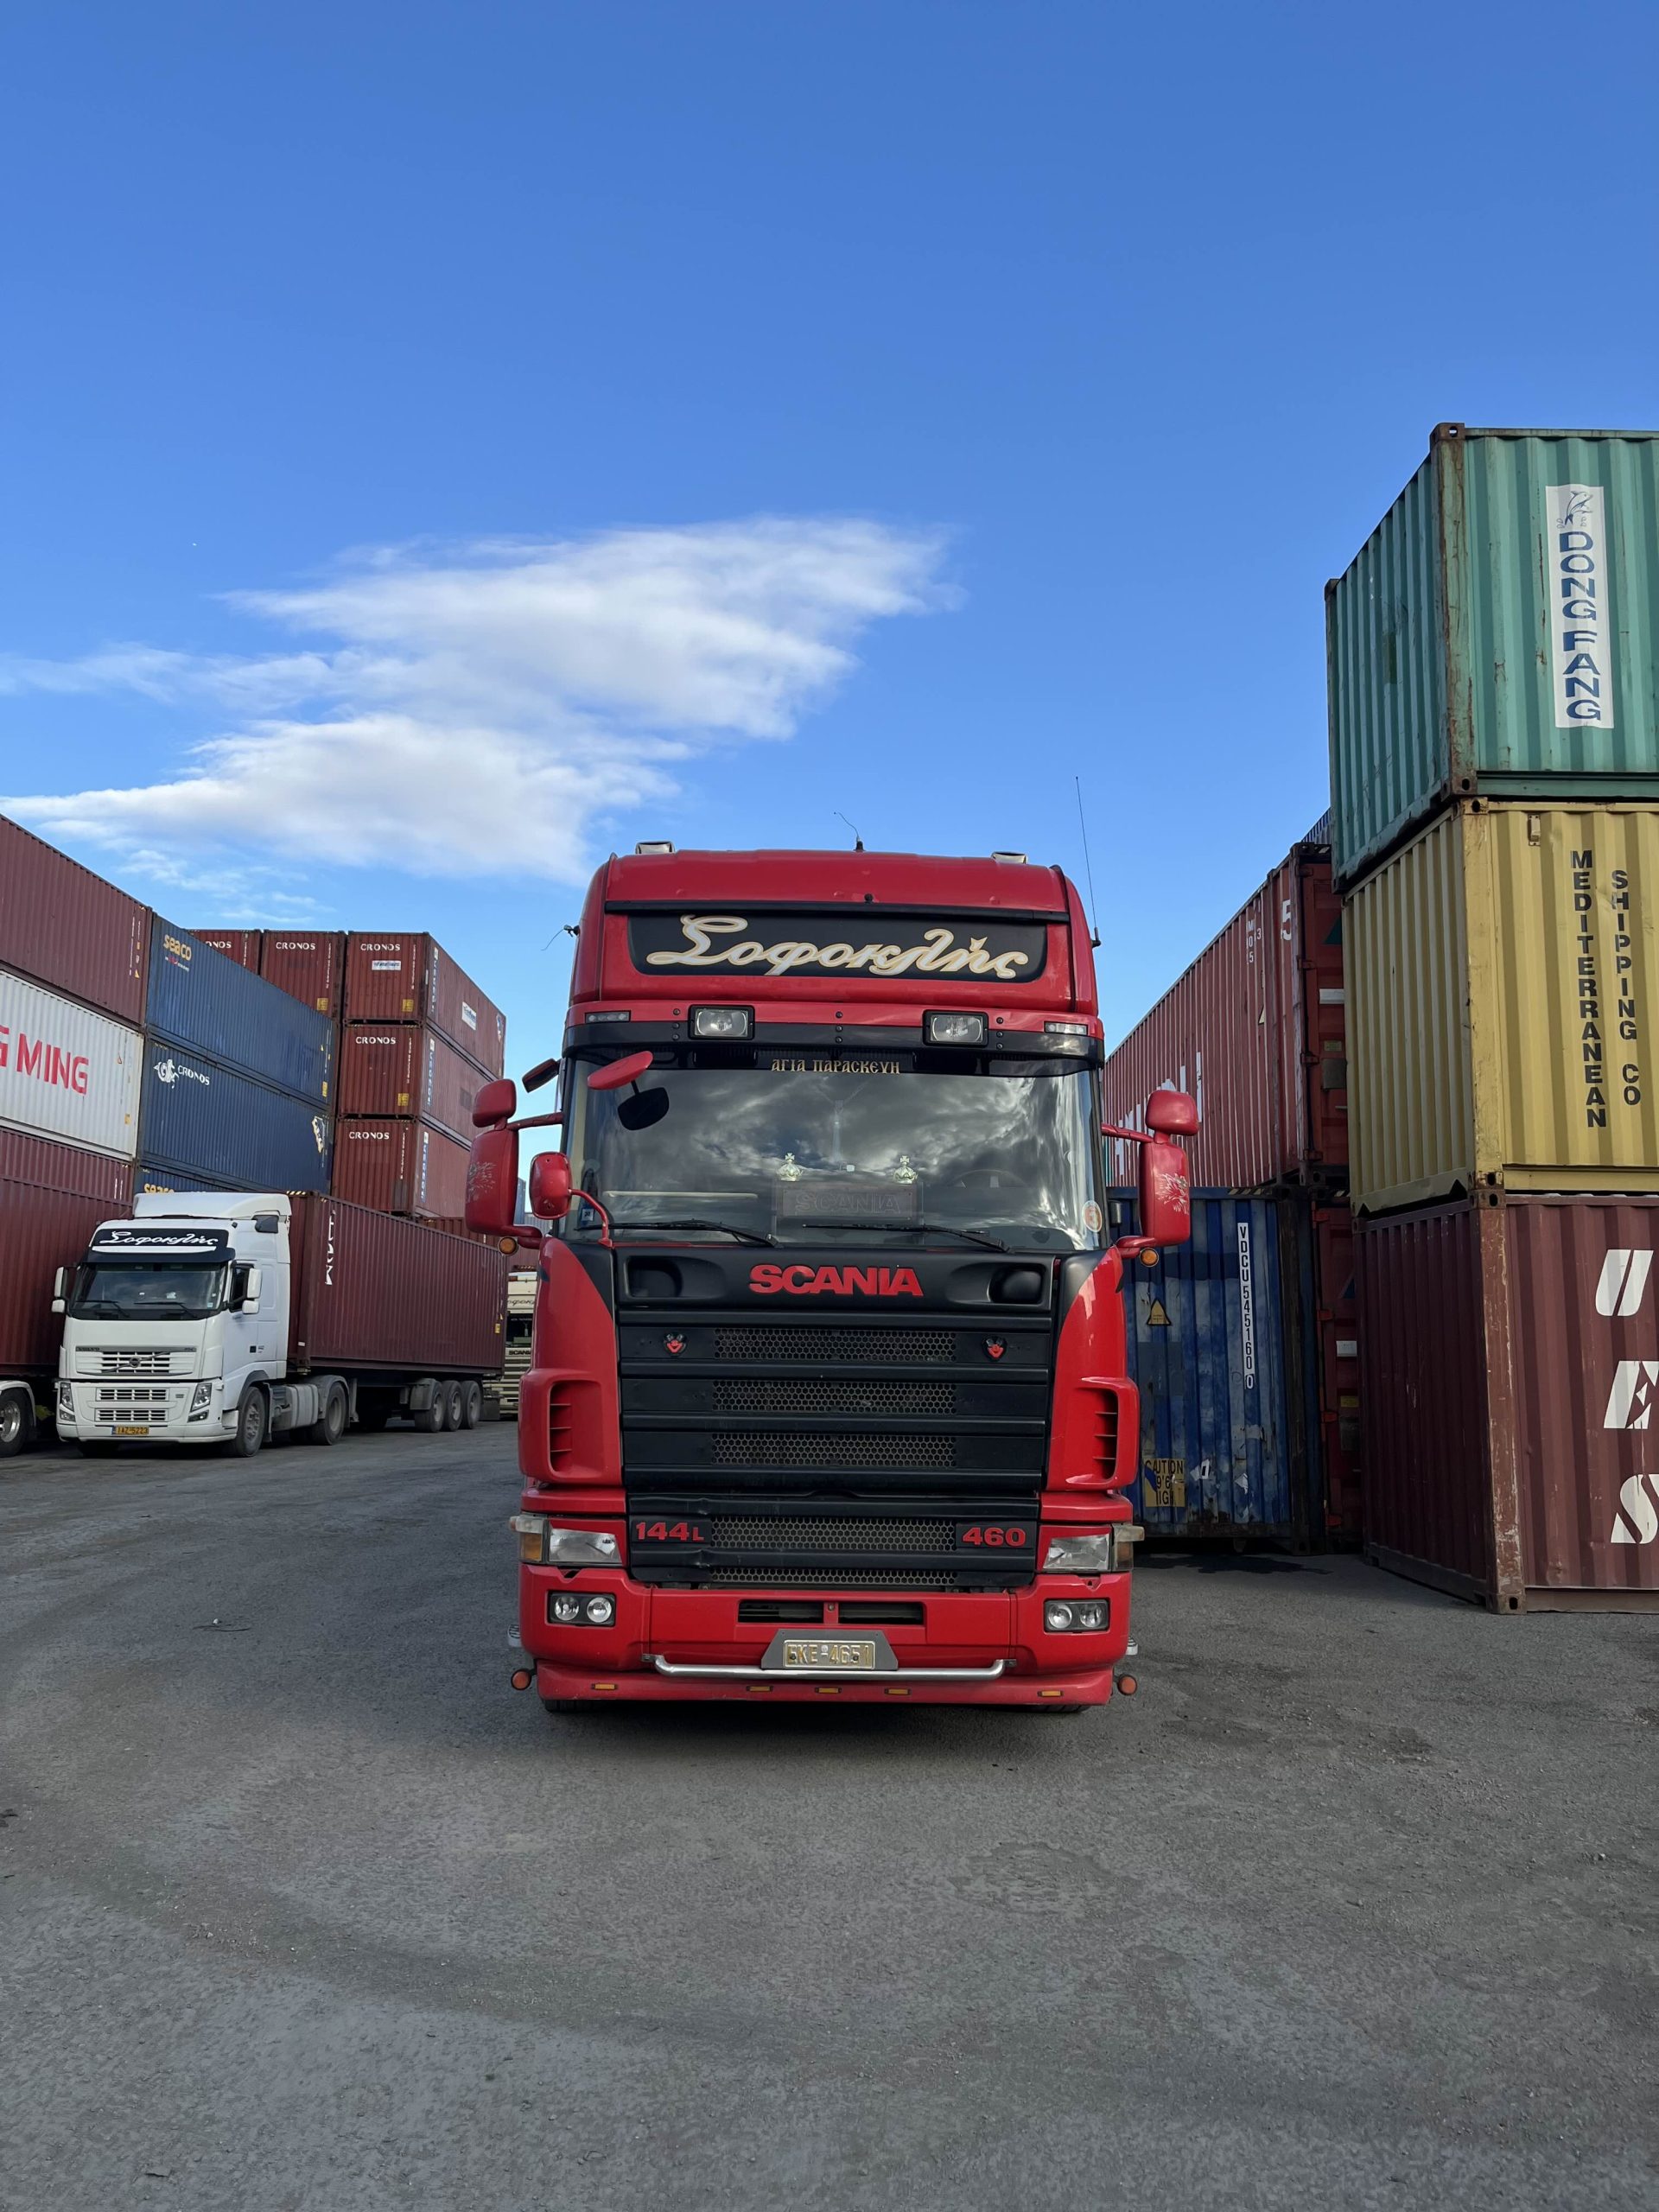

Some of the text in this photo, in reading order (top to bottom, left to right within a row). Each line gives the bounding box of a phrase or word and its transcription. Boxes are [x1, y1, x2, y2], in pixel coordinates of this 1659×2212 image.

[1559, 531, 1601, 721] DONG FANG
[163, 934, 192, 962] seaco
[276, 941, 316, 950] CRONOS
[359, 943, 401, 951] CRONOS
[1570, 850, 1607, 1128] MEDITERRANEAN
[1611, 869, 1642, 1106] SHIPPING CO
[355, 1036, 397, 1045] CRONOS
[16, 1033, 90, 1096] MING
[177, 1065, 210, 1086] CRONOS
[348, 1131, 390, 1140] CRONOS
[1239, 1225, 1250, 1282] VDCU
[748, 1264, 925, 1297] SCANIA
[1242, 1285, 1253, 1370] 545160
[962, 1527, 1027, 1547] 460
